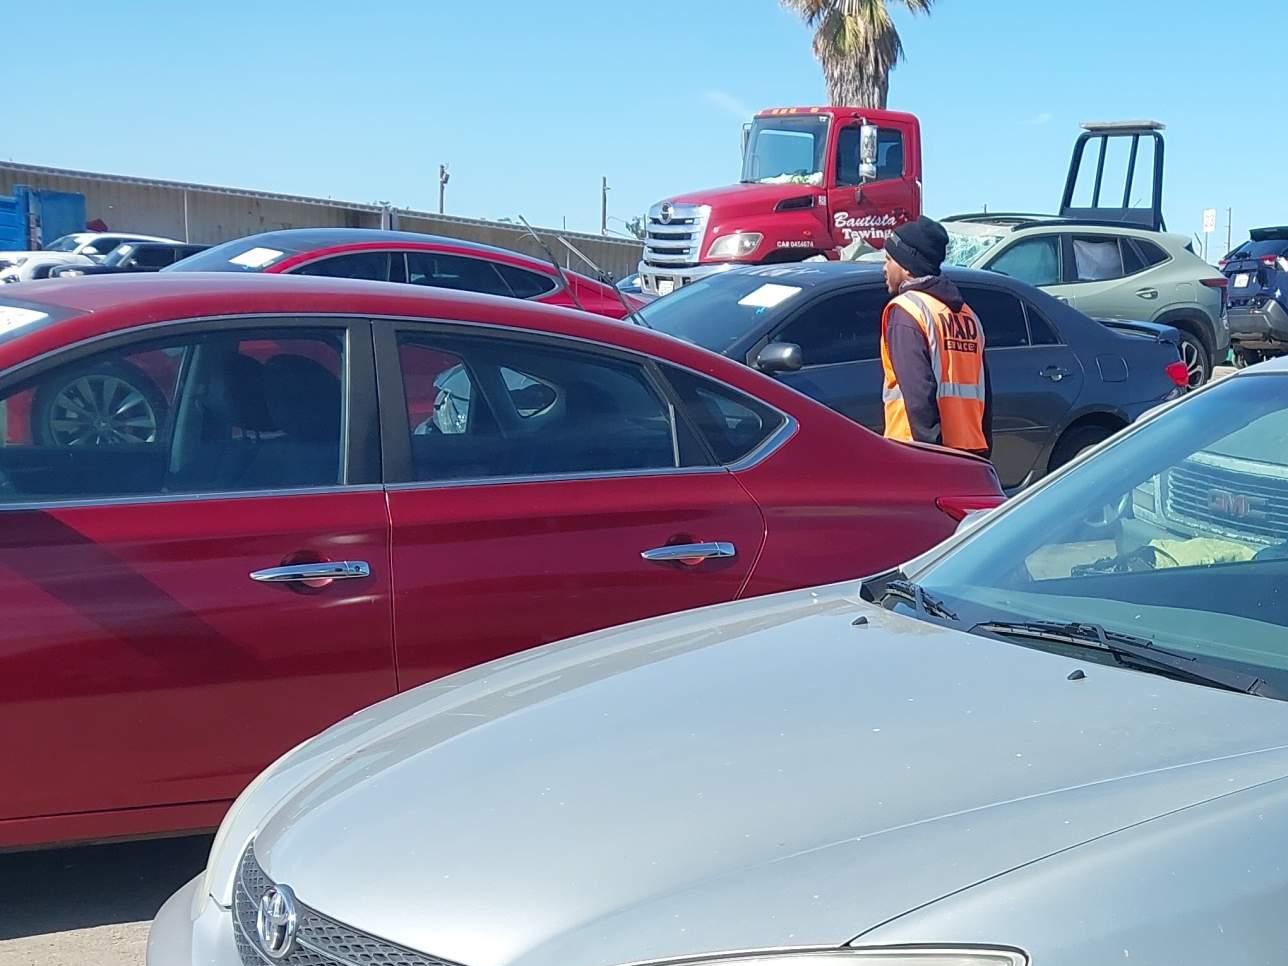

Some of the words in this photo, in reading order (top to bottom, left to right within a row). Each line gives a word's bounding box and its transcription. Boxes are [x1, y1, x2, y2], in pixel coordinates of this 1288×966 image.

[834, 211, 897, 228] Bautista
[842, 228, 895, 241] Towing
[938, 313, 978, 341] MAD
